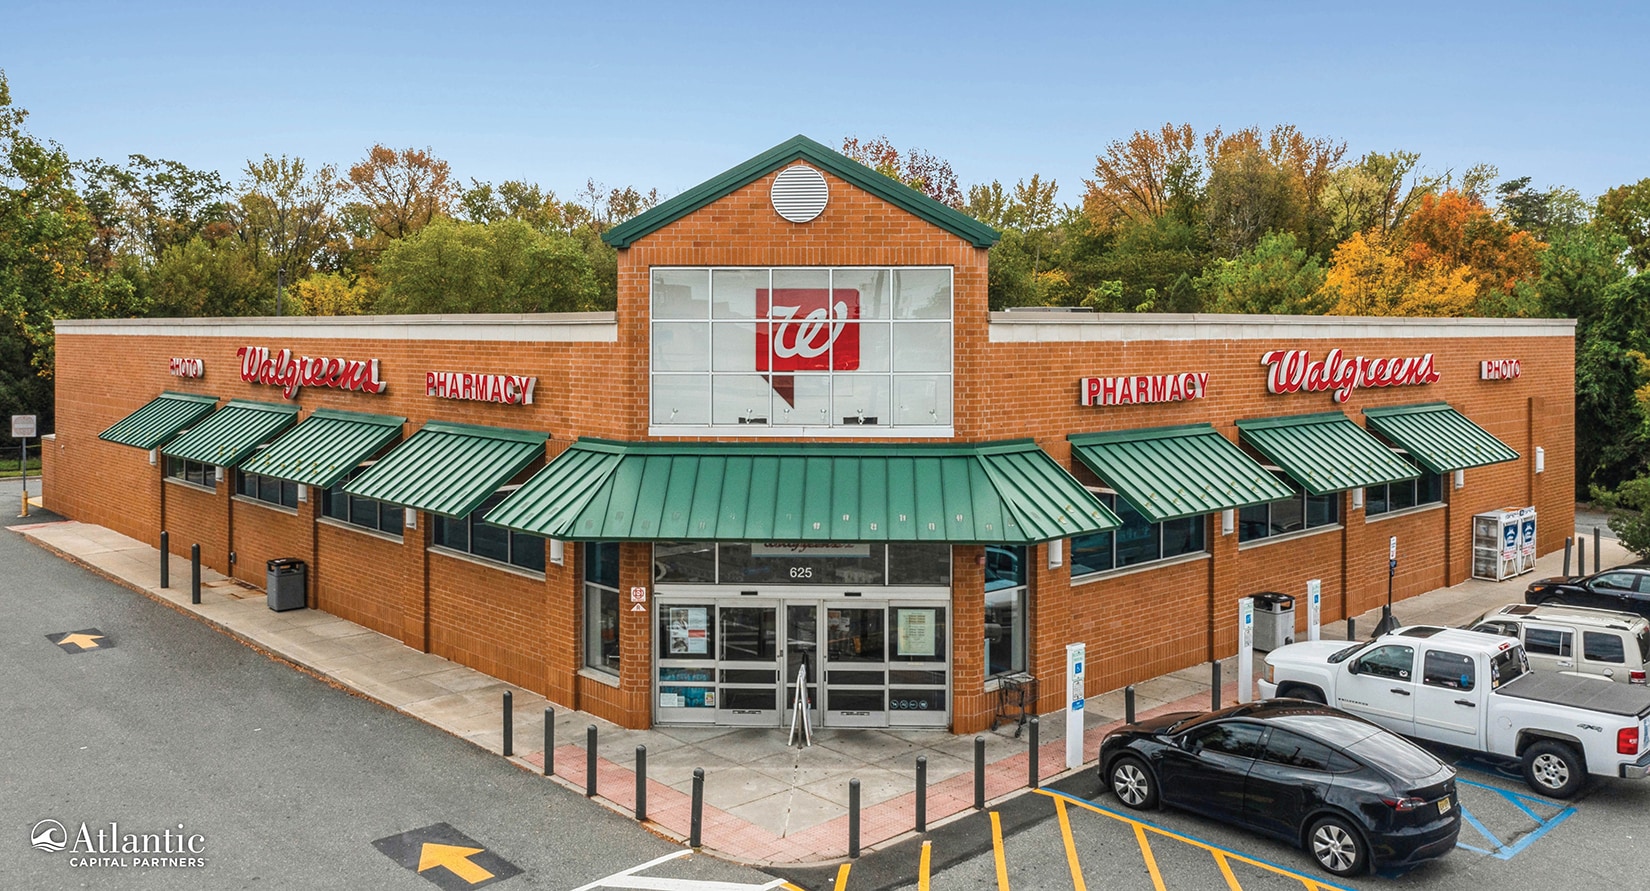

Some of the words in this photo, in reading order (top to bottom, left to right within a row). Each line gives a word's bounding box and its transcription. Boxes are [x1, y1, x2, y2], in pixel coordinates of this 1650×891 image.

[170, 357, 202, 378] PHOTO
[237, 346, 386, 400] Walgreens
[1261, 349, 1440, 403] Walgreens
[1483, 359, 1521, 380] PHOTO
[426, 372, 536, 405] PHARMACY
[1082, 373, 1210, 406] PHARMACY
[789, 567, 813, 578] 625
